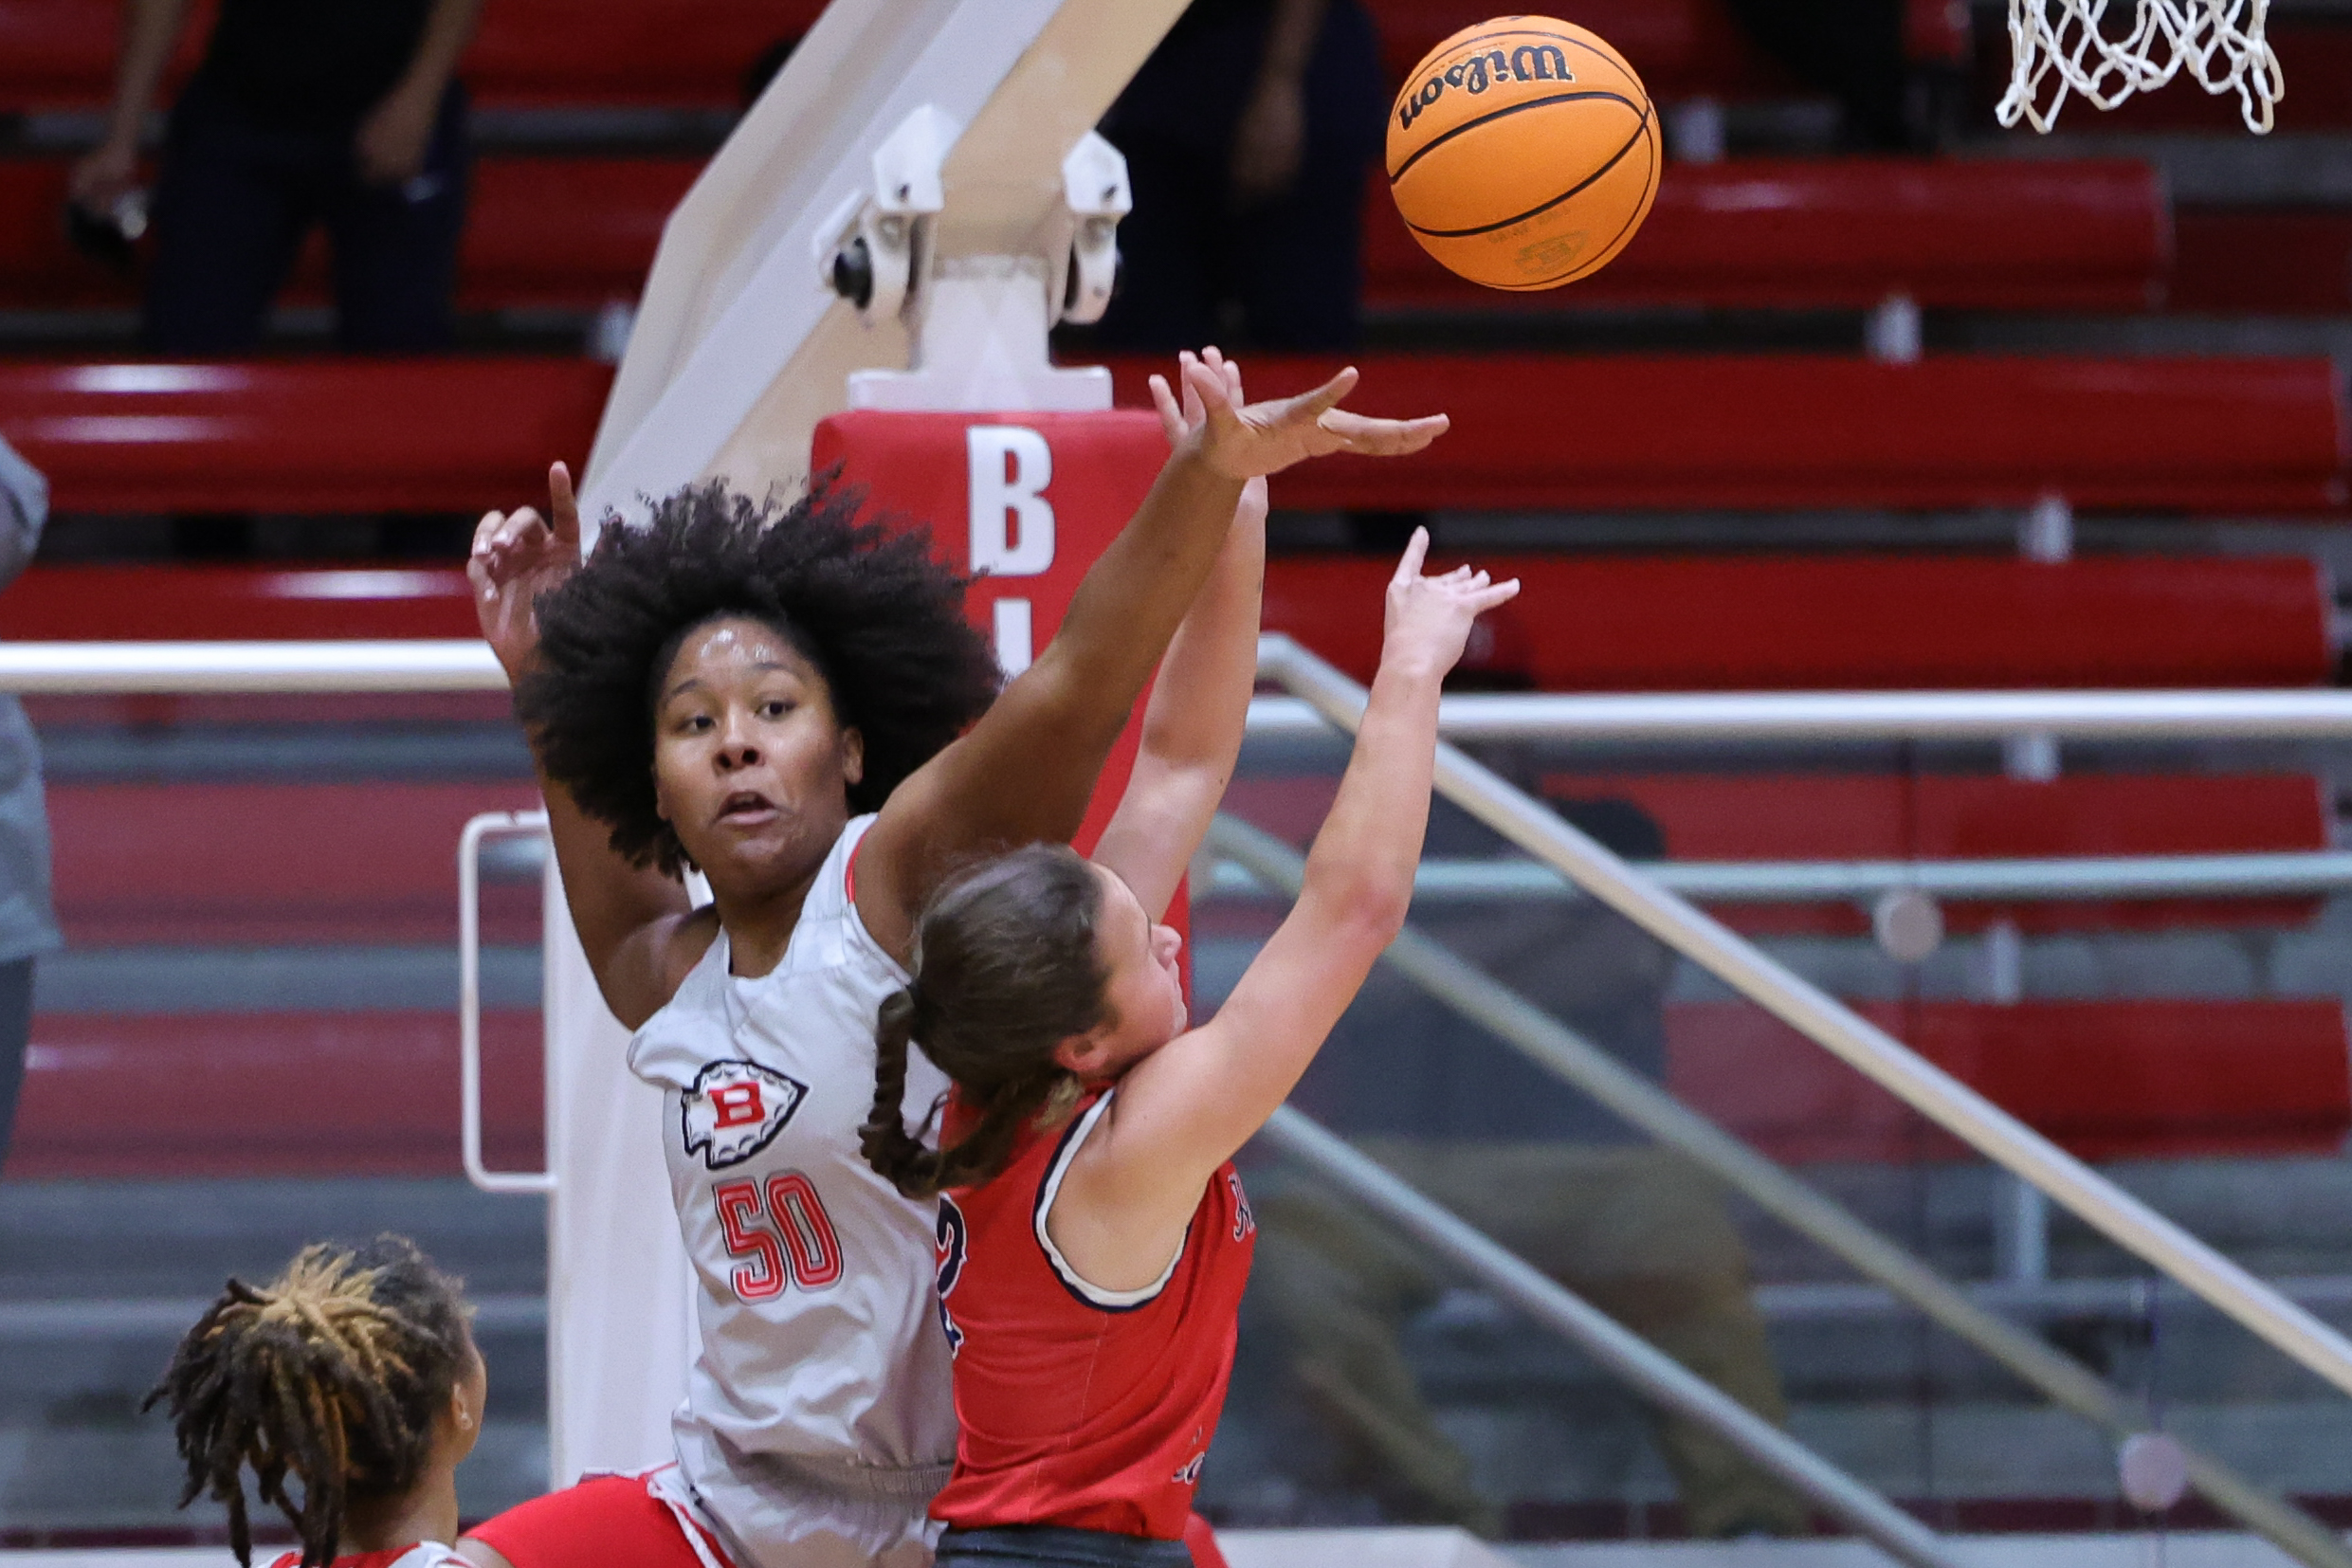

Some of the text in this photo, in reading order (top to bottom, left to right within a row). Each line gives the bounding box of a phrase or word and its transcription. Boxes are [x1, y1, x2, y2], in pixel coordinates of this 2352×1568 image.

[1398, 45, 1576, 131] Wilson
[708, 1082, 766, 1129] B
[713, 1173, 844, 1304] 50
